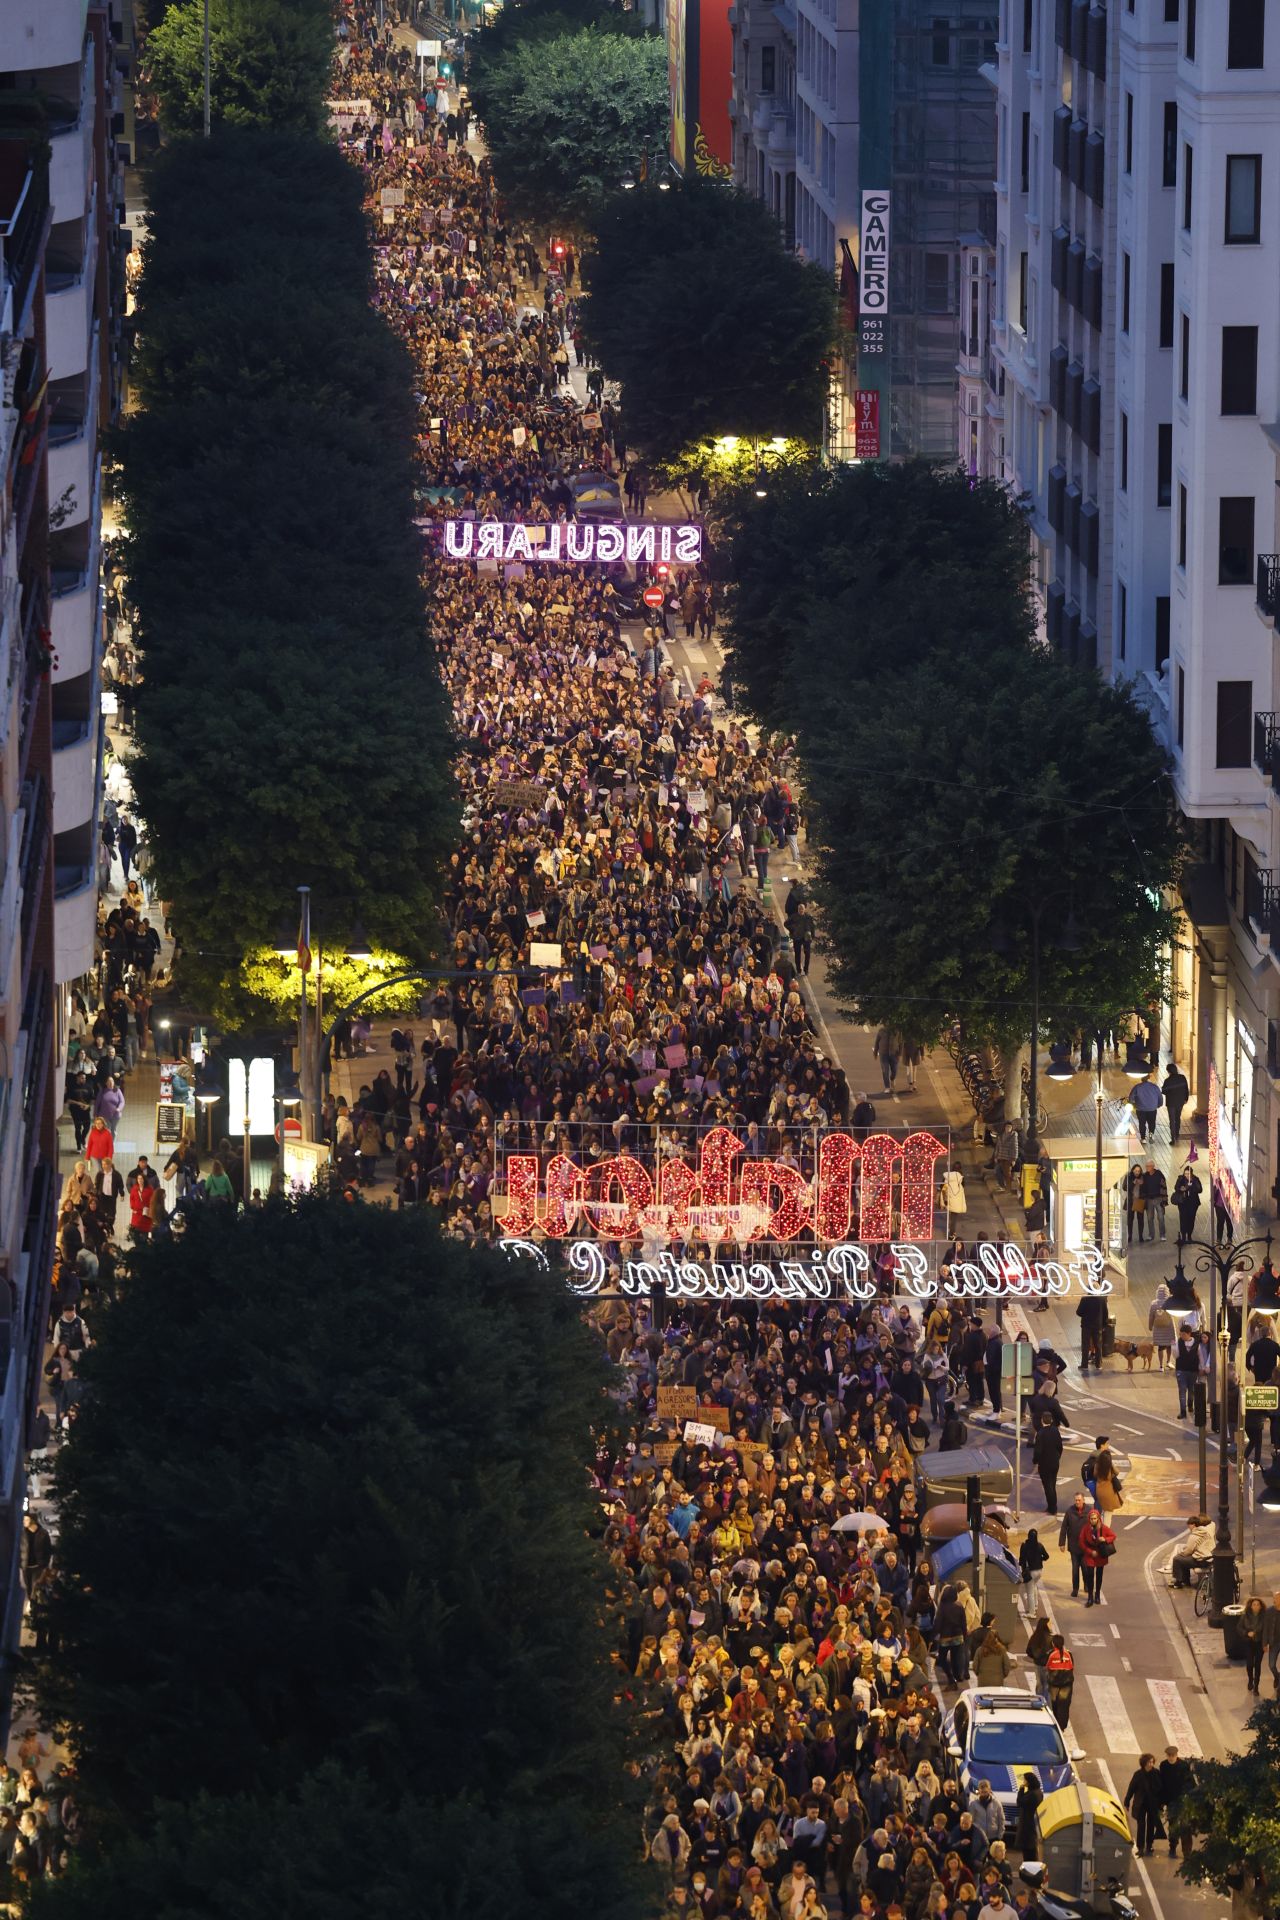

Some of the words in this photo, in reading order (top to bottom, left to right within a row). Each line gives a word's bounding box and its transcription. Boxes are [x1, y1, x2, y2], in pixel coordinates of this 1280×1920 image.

[863, 197, 888, 308] GAMERO
[862, 320, 883, 329] 961
[862, 332, 884, 341] 022
[862, 344, 884, 353] 355
